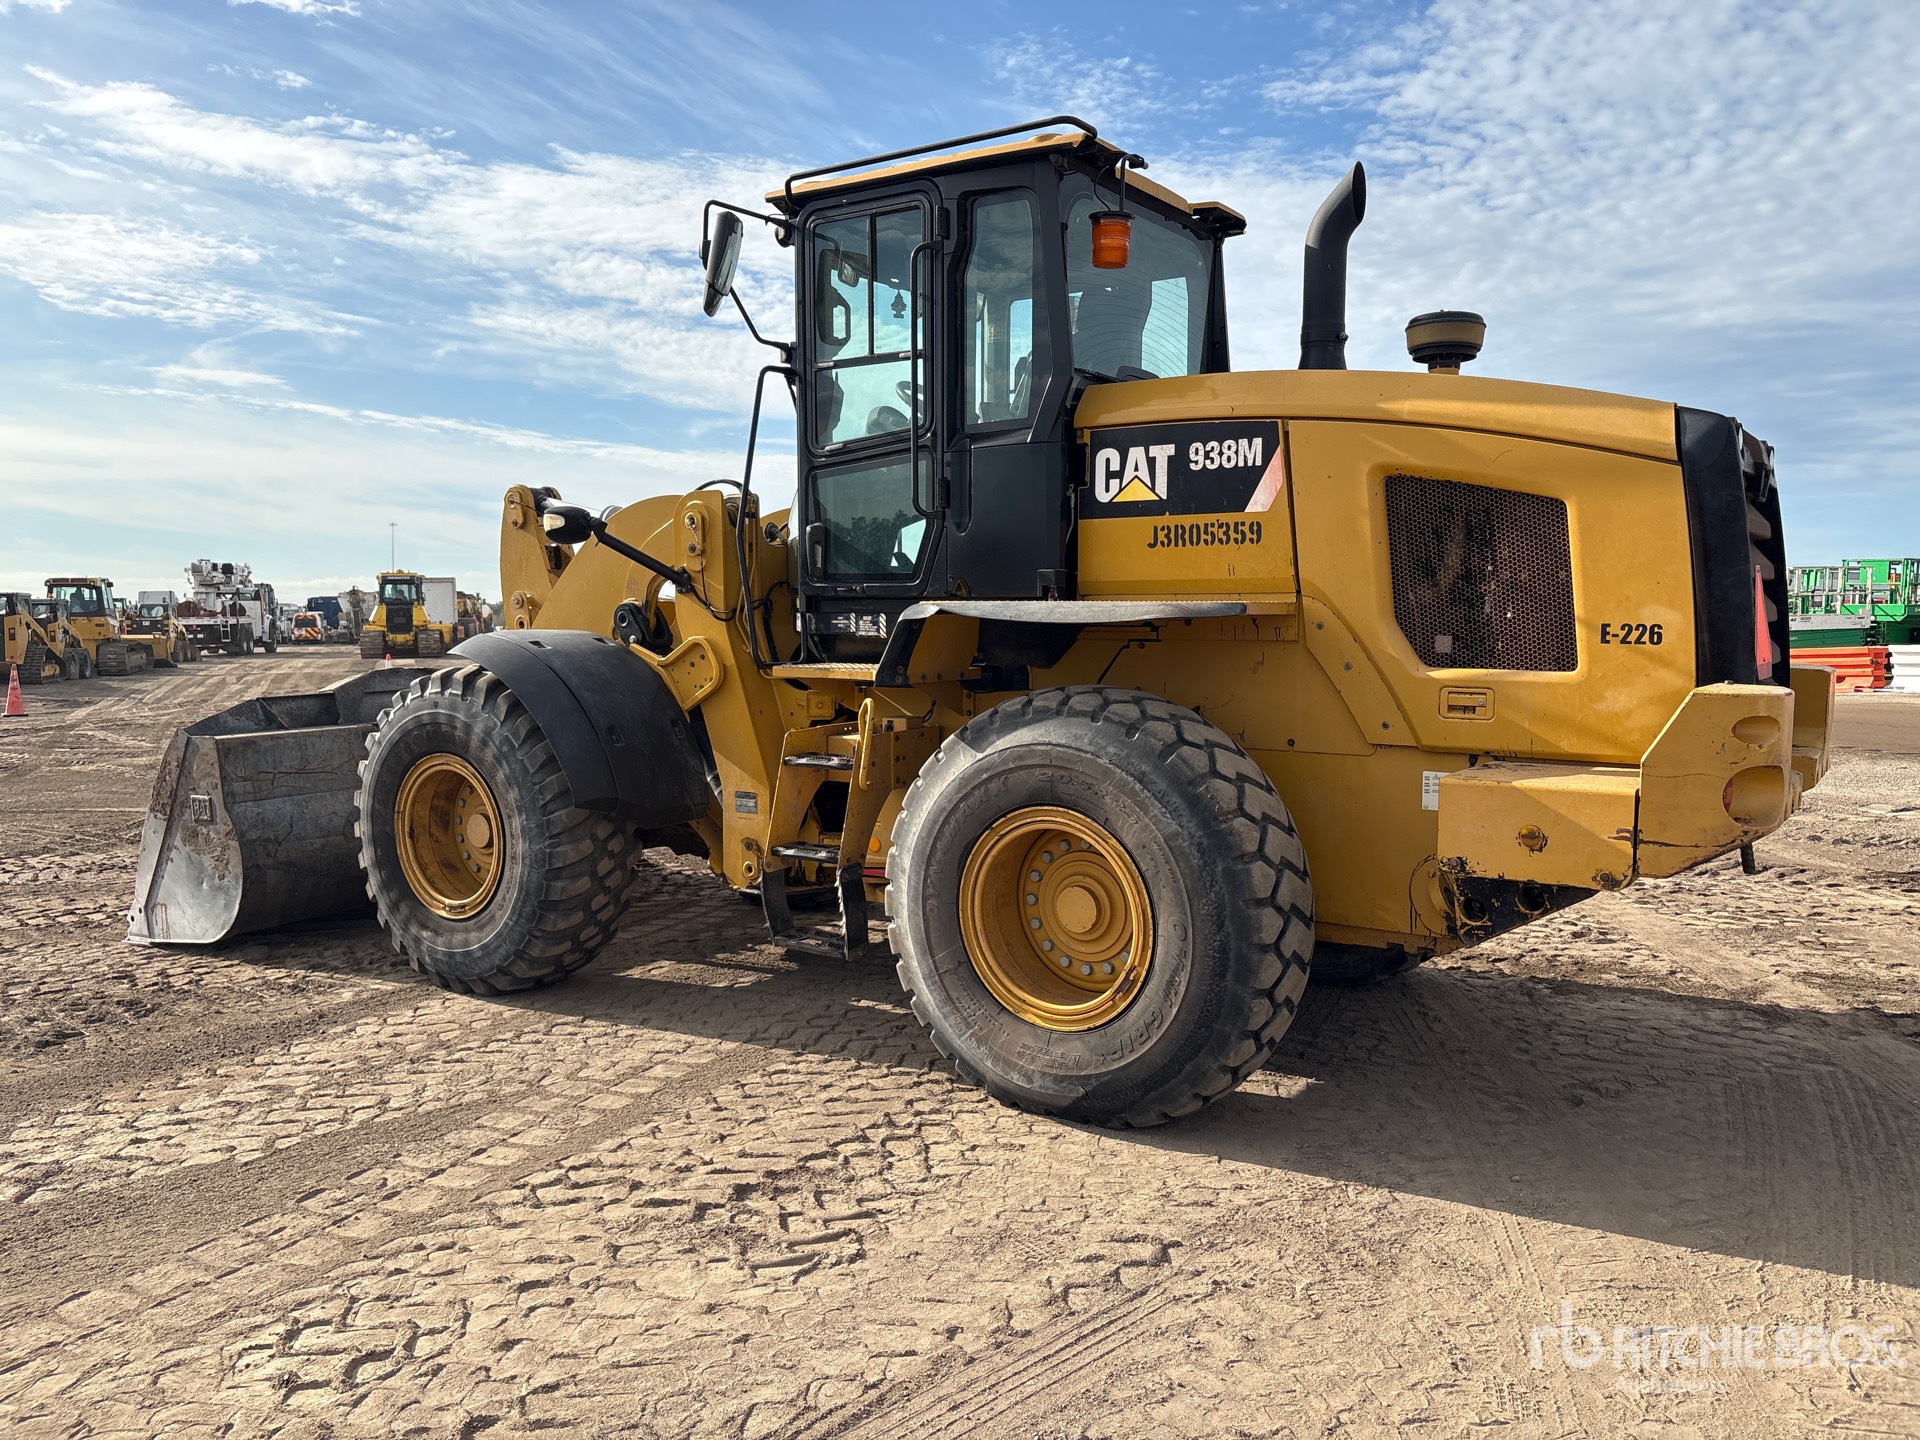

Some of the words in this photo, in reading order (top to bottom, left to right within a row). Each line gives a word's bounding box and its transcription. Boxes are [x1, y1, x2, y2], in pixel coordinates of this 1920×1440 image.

[1189, 437, 1263, 471] 938M
[1095, 444, 1175, 503] CAT
[1147, 521, 1262, 549] J3R05359
[1600, 623, 1663, 645] E-226
